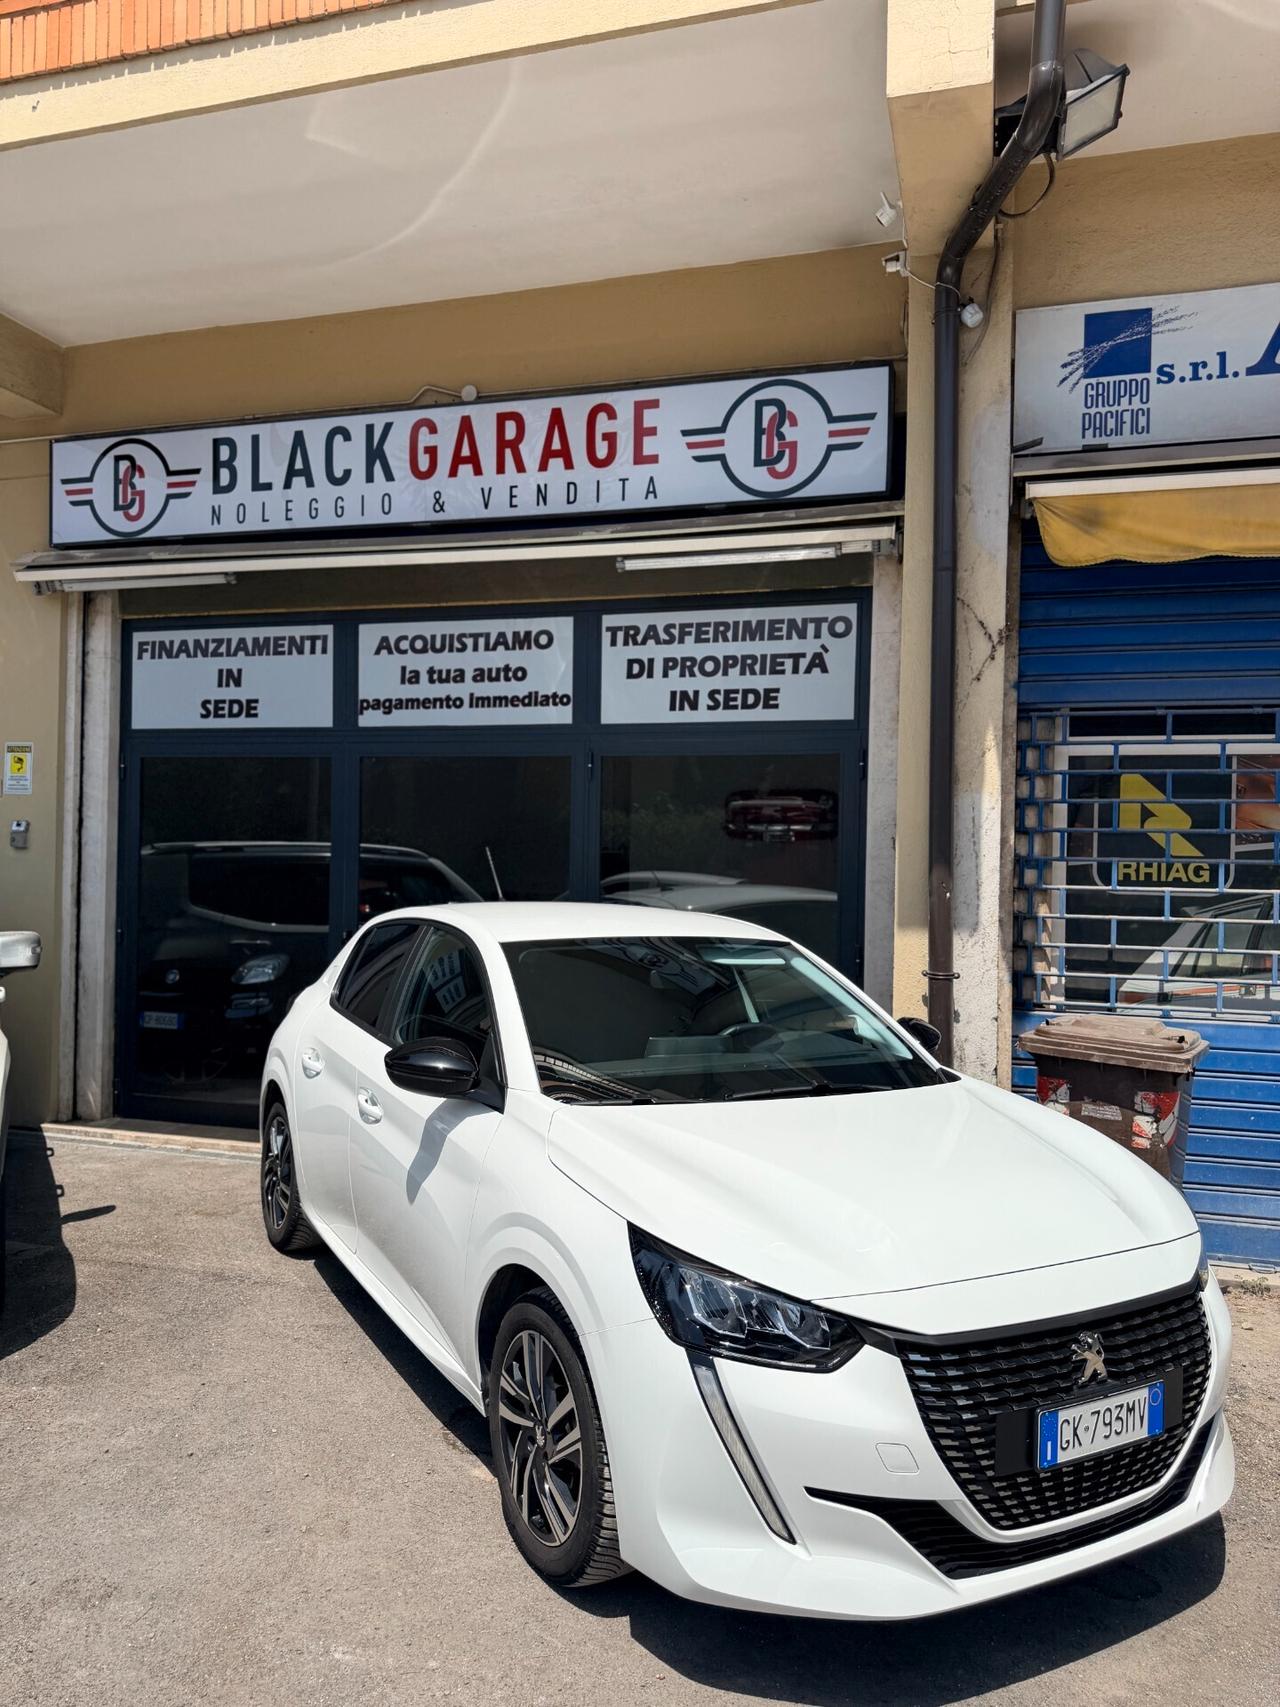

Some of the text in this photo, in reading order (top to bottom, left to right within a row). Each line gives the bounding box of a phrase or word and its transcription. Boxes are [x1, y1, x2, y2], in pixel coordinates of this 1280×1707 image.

[1156, 351, 1239, 384] s.r.l.
[1084, 378, 1150, 409] GRUPPO
[1082, 407, 1150, 439] PACIFICI
[211, 476, 657, 525] NOLEGGIO & VENDITA
[373, 630, 554, 655] ACQUISTIAMO
[605, 616, 853, 647] TRASFERIMENTO
[137, 634, 328, 660] FINANZIAMENTI
[400, 664, 527, 685] la tua auto
[626, 644, 830, 680] DI PROPRIETÀ
[217, 669, 243, 688] IN
[200, 699, 259, 718] SEDE
[359, 694, 464, 715] pagamento
[669, 688, 781, 712] IN SEDE
[1118, 861, 1210, 883] RHIAG
